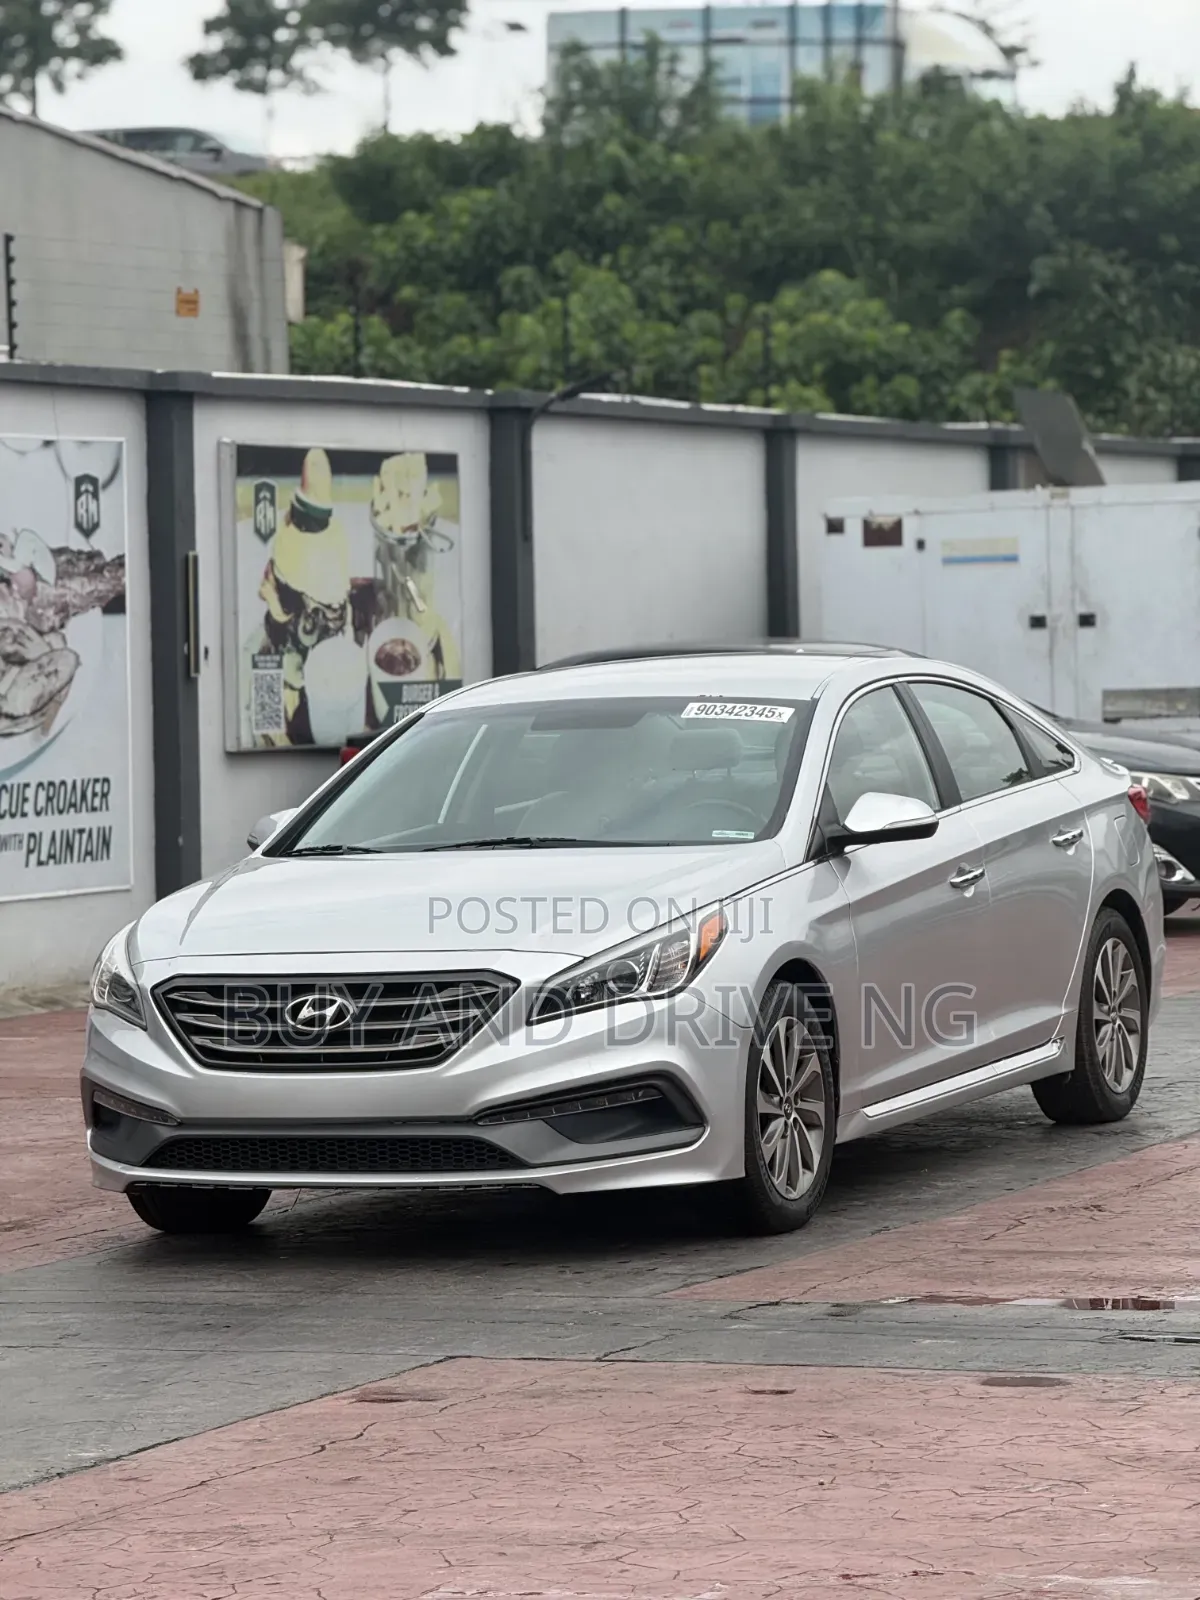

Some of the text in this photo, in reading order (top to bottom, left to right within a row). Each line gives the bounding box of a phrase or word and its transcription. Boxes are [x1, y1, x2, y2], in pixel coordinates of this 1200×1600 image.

[0, 777, 111, 819] CUE CROAKER
[25, 825, 113, 868] PLAINTAIN
